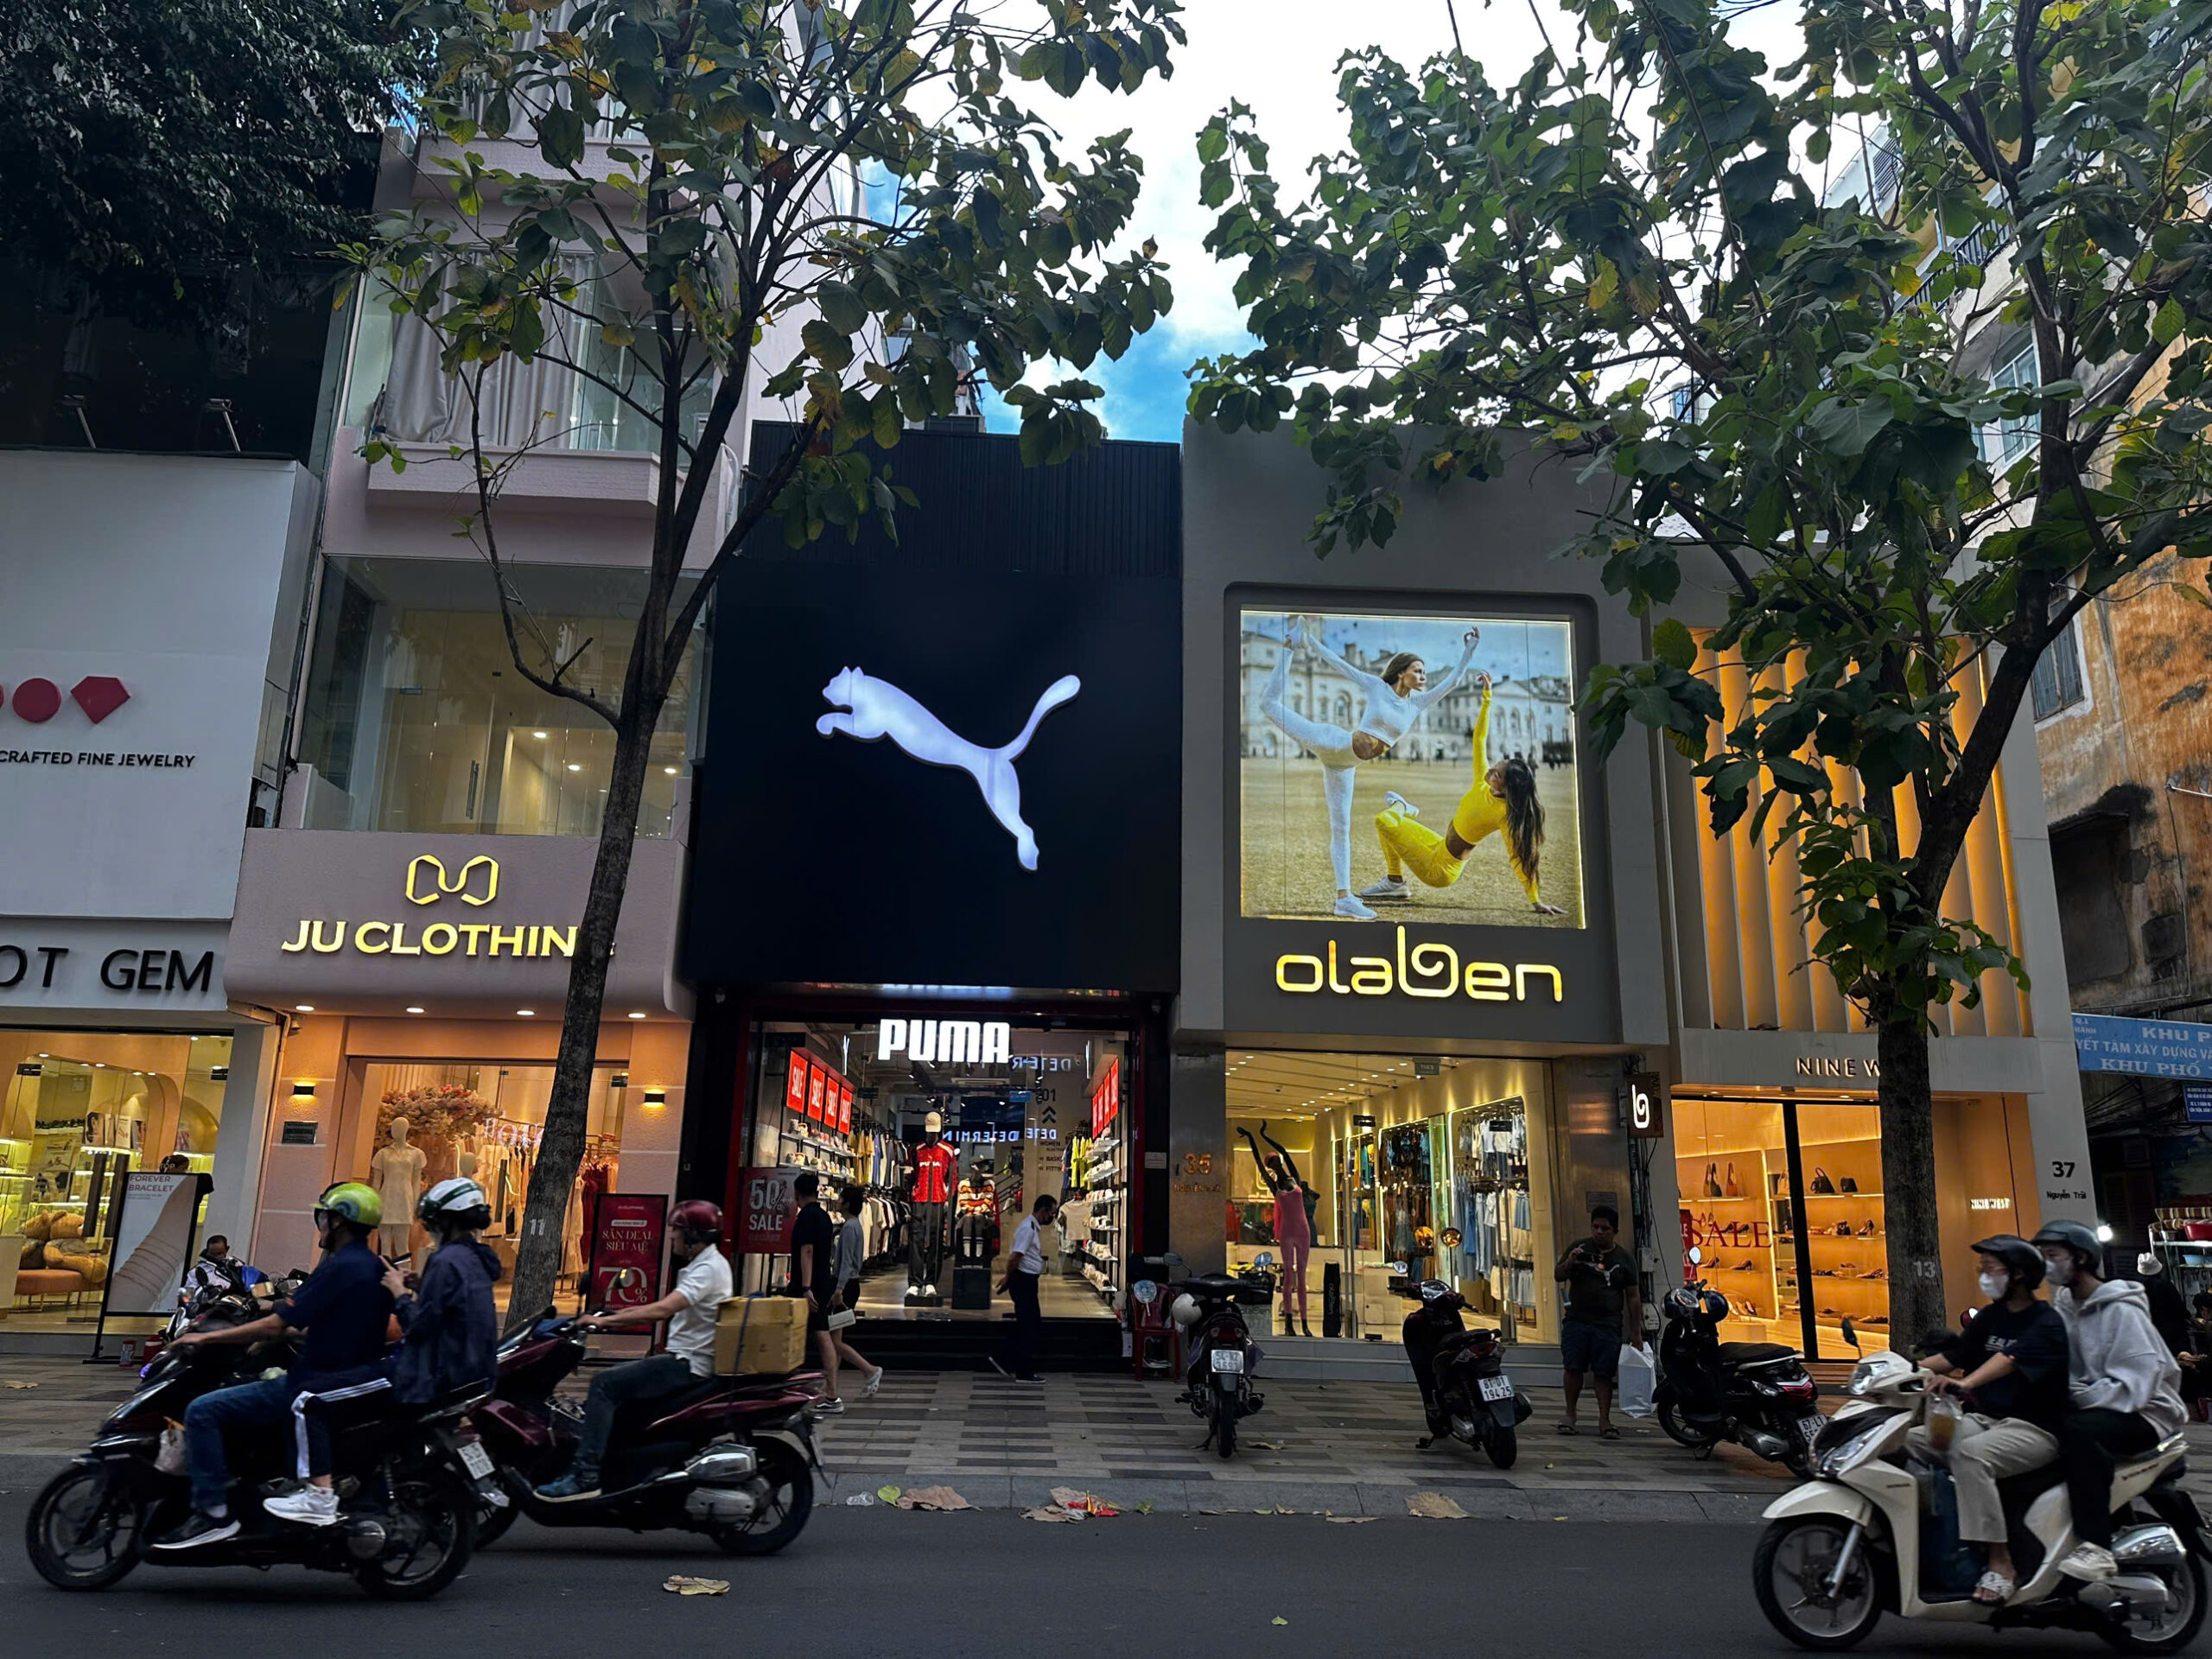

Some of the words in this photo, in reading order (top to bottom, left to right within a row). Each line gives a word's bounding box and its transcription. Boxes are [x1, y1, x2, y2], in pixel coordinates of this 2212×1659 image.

[0, 750, 73, 765] CRAFTED
[78, 753, 115, 766] FINE
[118, 753, 195, 768] JEWELRY
[282, 920, 346, 952] JU
[354, 921, 615, 957] CLOTHIN
[100, 949, 214, 992] GEM
[1276, 925, 1562, 1002] olaben
[878, 1019, 1010, 1064] PUMA
[2142, 1027, 2190, 1041] KHU
[2134, 1042, 2158, 1055] XÂY
[1796, 1058, 1857, 1077] NINE
[2100, 1058, 2149, 1073] KHU
[2157, 1059, 2202, 1077] PHỐ
[1184, 1154, 1211, 1174] 35
[2052, 1160, 2075, 1178] 37
[129, 1184, 174, 1192] BRACELET
[749, 1214, 784, 1230] SALE
[1691, 1219, 1772, 1248] SALE
[1912, 1261, 1936, 1278] 13
